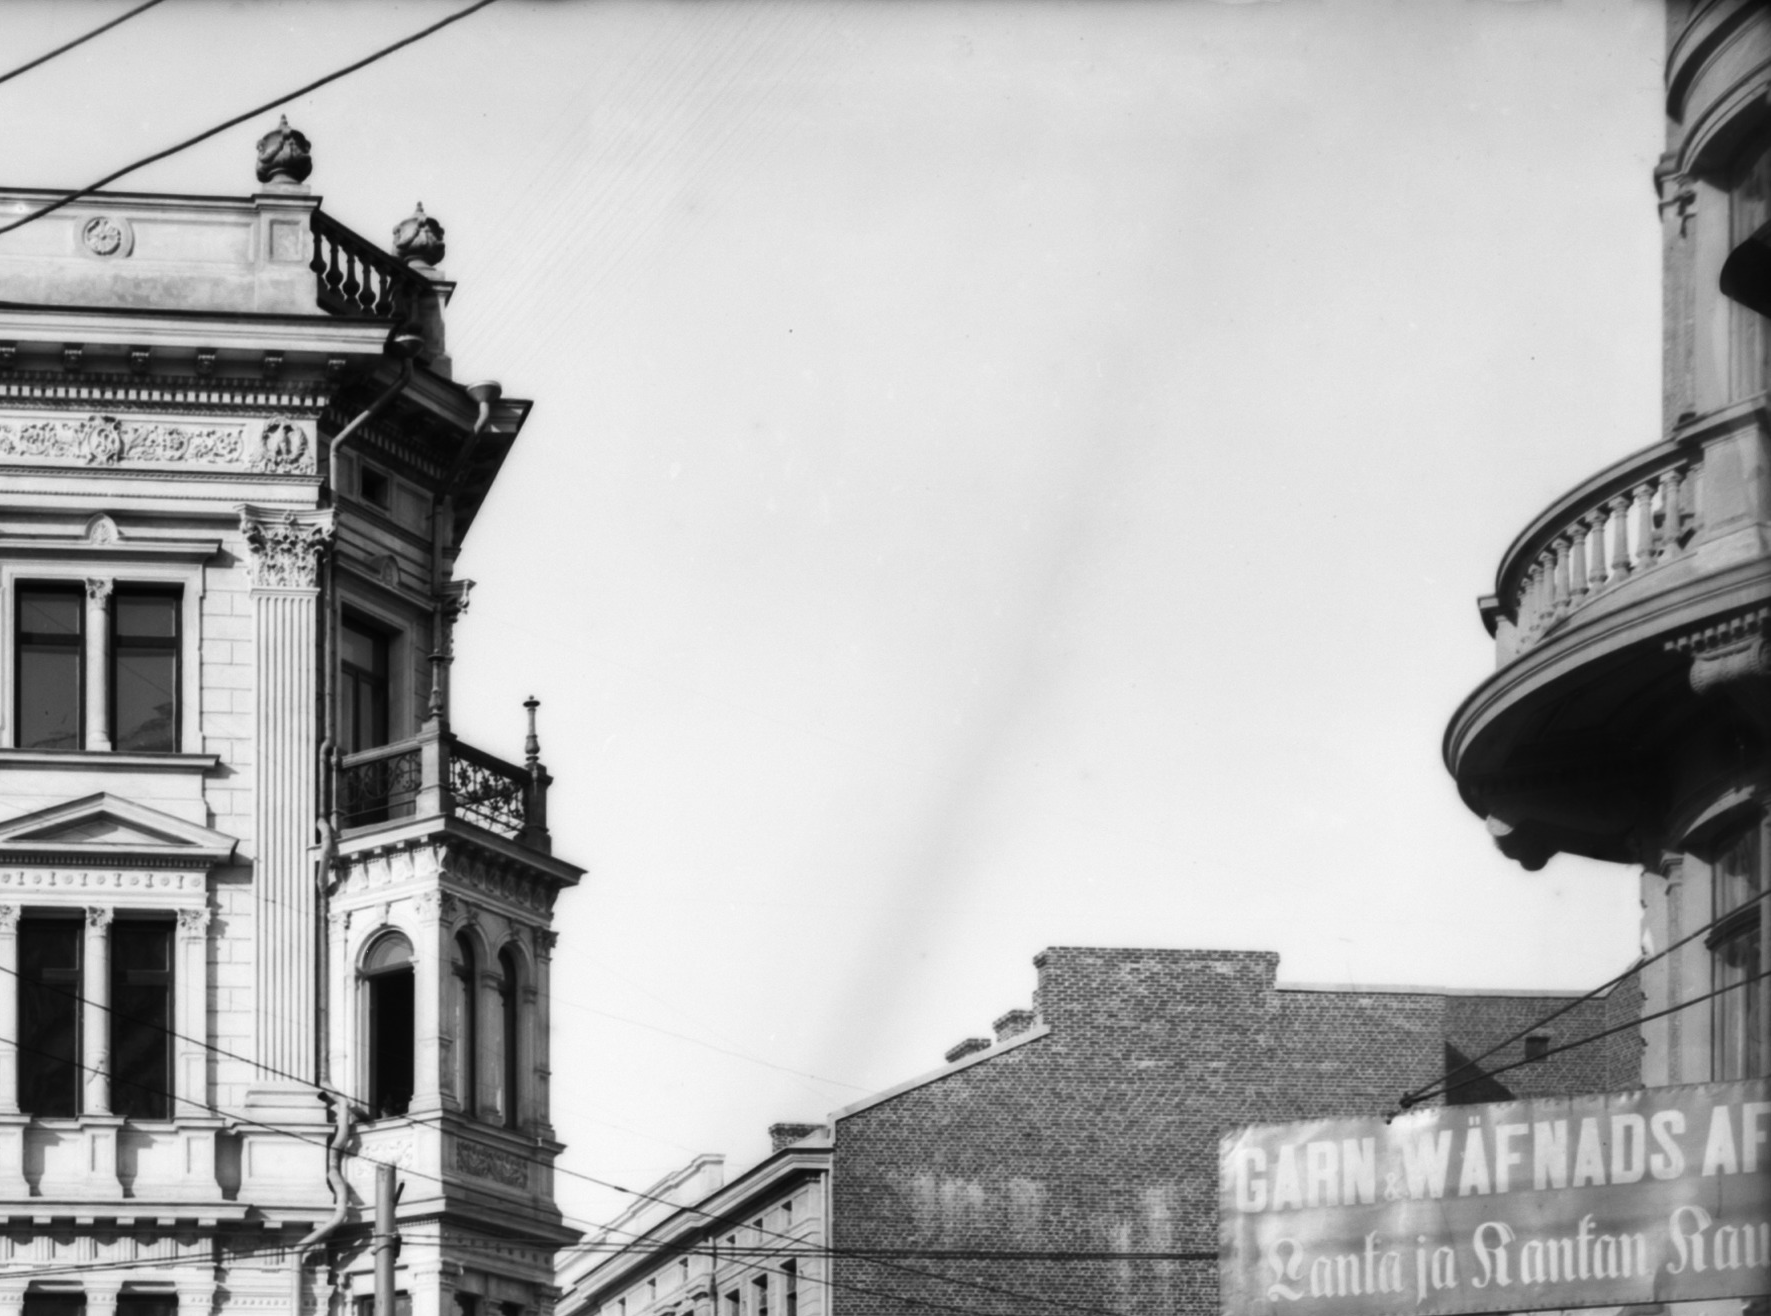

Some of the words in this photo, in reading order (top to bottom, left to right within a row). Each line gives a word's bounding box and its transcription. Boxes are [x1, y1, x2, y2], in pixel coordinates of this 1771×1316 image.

[1235, 1137, 1376, 1212] GARN
[1384, 1172, 1403, 1199] &
[1400, 1109, 1687, 1201] WÄFNADS
[1415, 1234, 1458, 1305] ja
